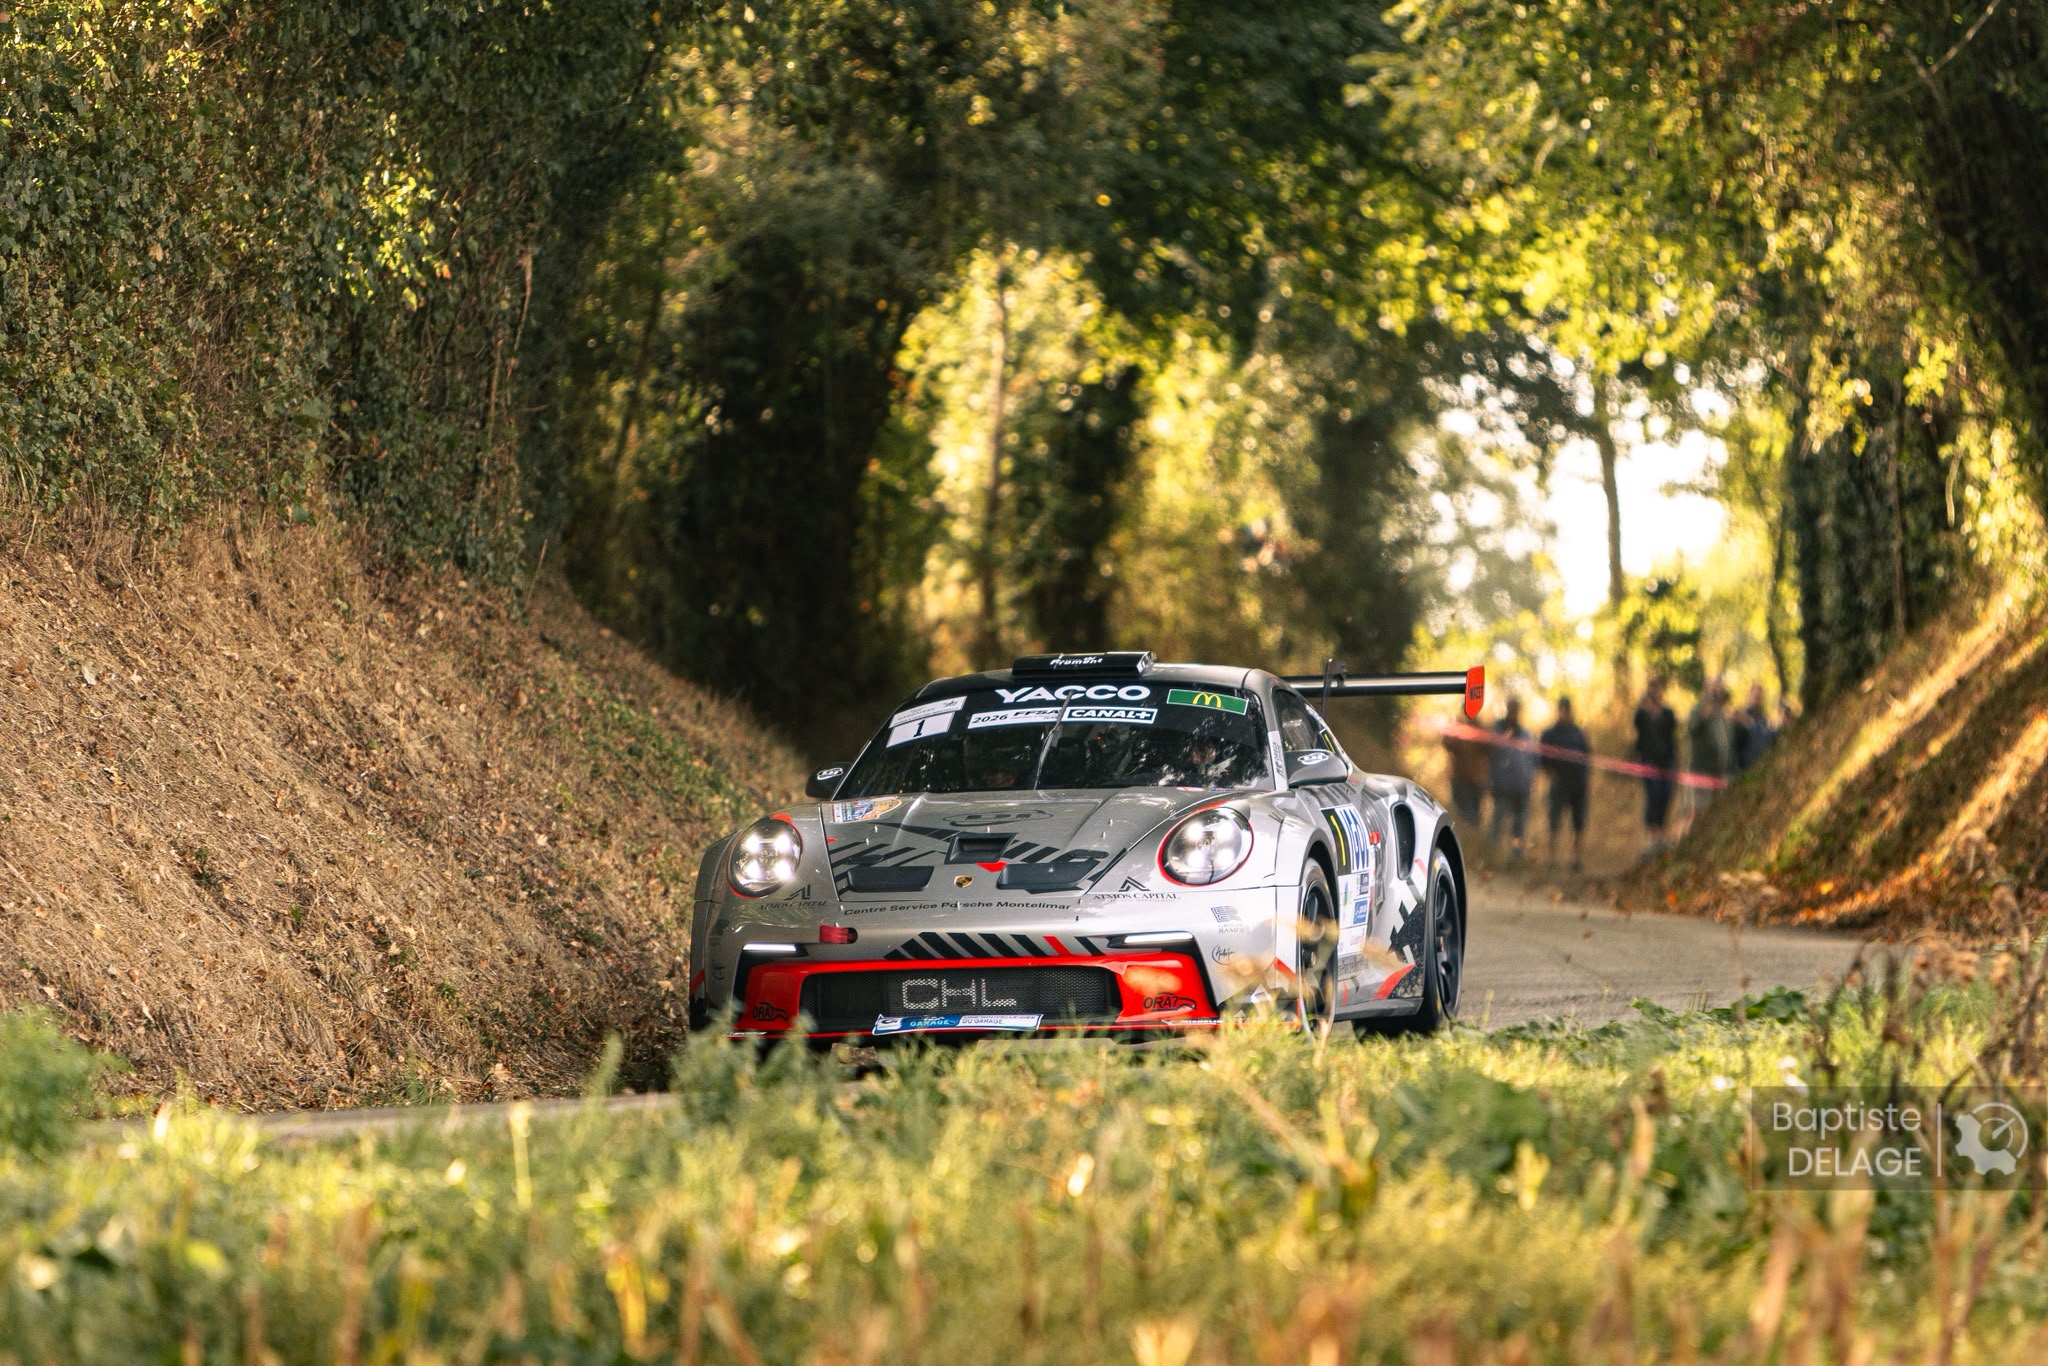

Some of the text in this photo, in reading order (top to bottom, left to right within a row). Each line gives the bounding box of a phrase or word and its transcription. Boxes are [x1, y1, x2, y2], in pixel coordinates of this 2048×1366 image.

[994, 685, 1151, 704] YACCO
[971, 713, 1008, 725] 2026
[1013, 709, 1060, 717] FFSA
[1071, 708, 1151, 720] CANAL+
[912, 719, 926, 738] 1
[844, 902, 886, 916] Centre
[889, 898, 938, 911] Service
[902, 978, 1017, 1010] CHL
